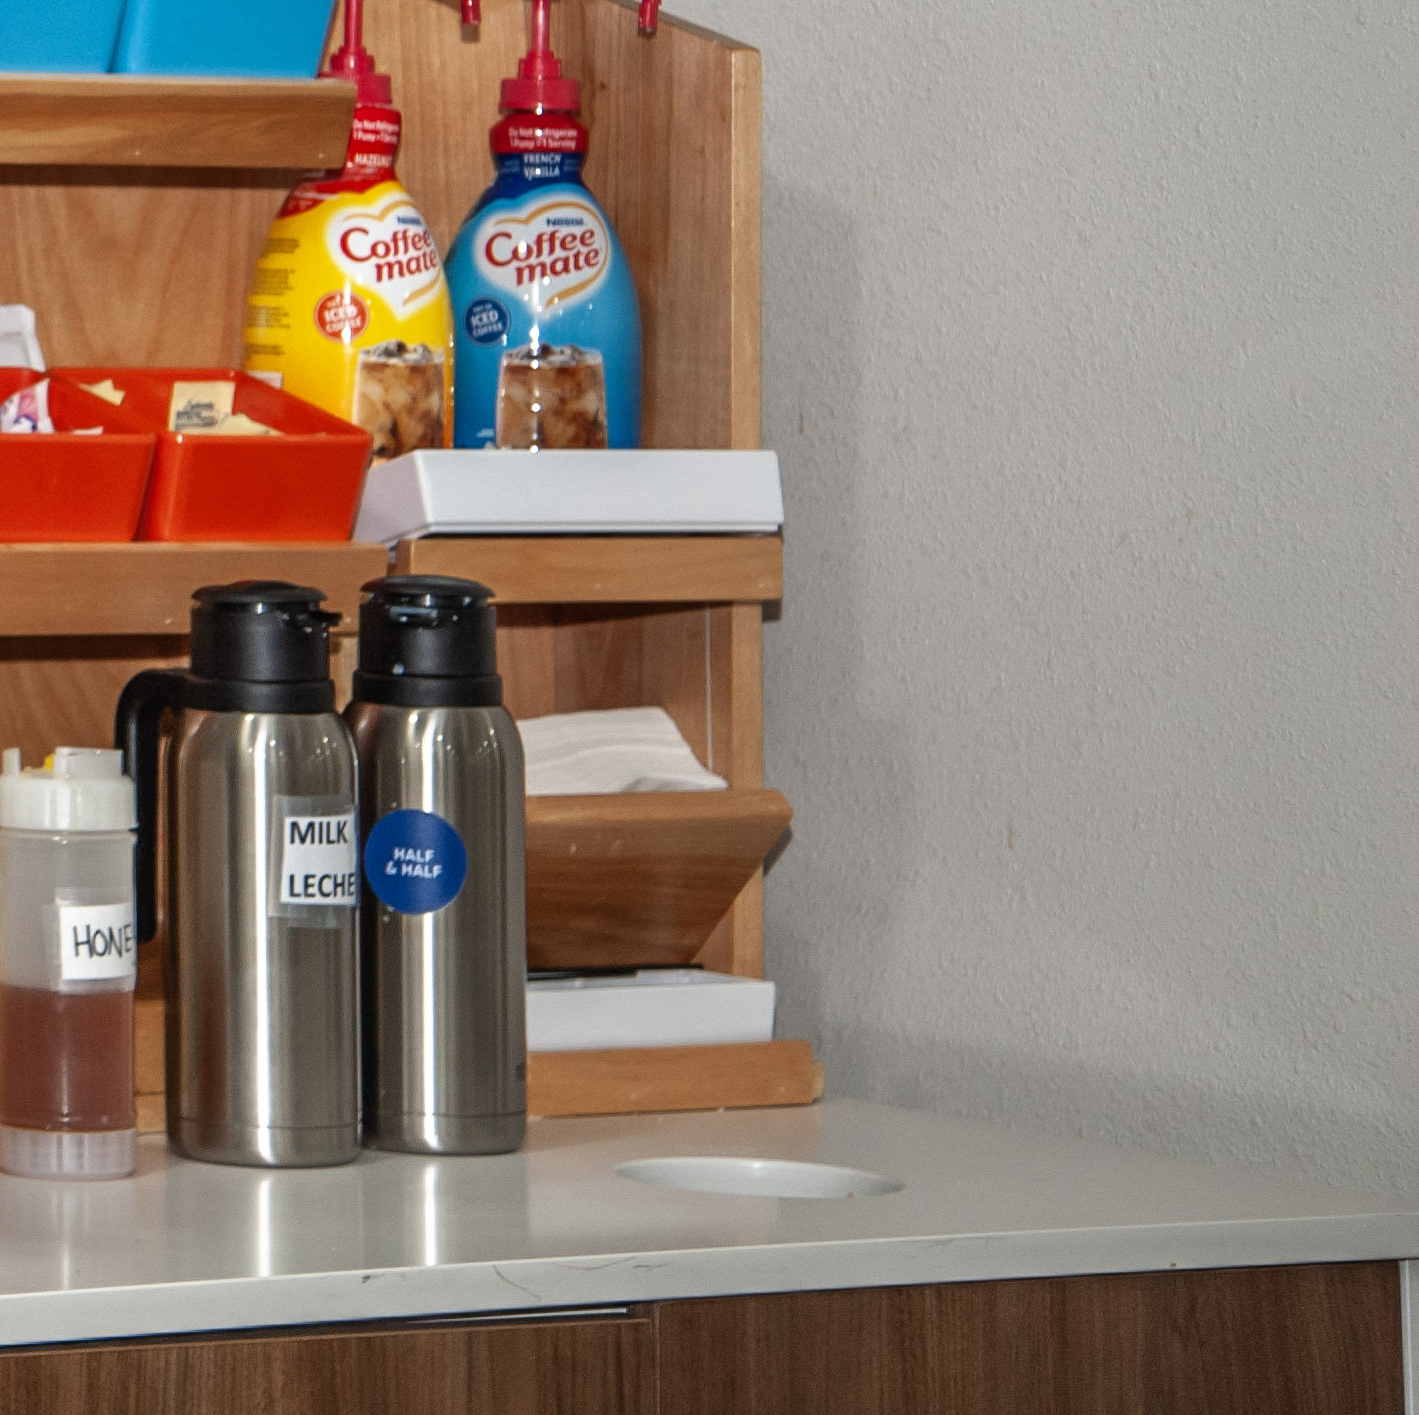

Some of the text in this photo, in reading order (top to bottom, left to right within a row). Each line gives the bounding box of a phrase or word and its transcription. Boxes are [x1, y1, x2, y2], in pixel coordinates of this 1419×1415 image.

[340, 226, 431, 262] Coffee
[485, 229, 595, 267] Coffee
[375, 249, 438, 282] mate
[515, 249, 600, 286] mate
[470, 309, 499, 326] ICED
[289, 820, 349, 845] MILK
[386, 860, 443, 879] & HALF
[394, 847, 435, 863] HALF
[288, 872, 356, 898] LECHE
[72, 923, 133, 959] HONE
